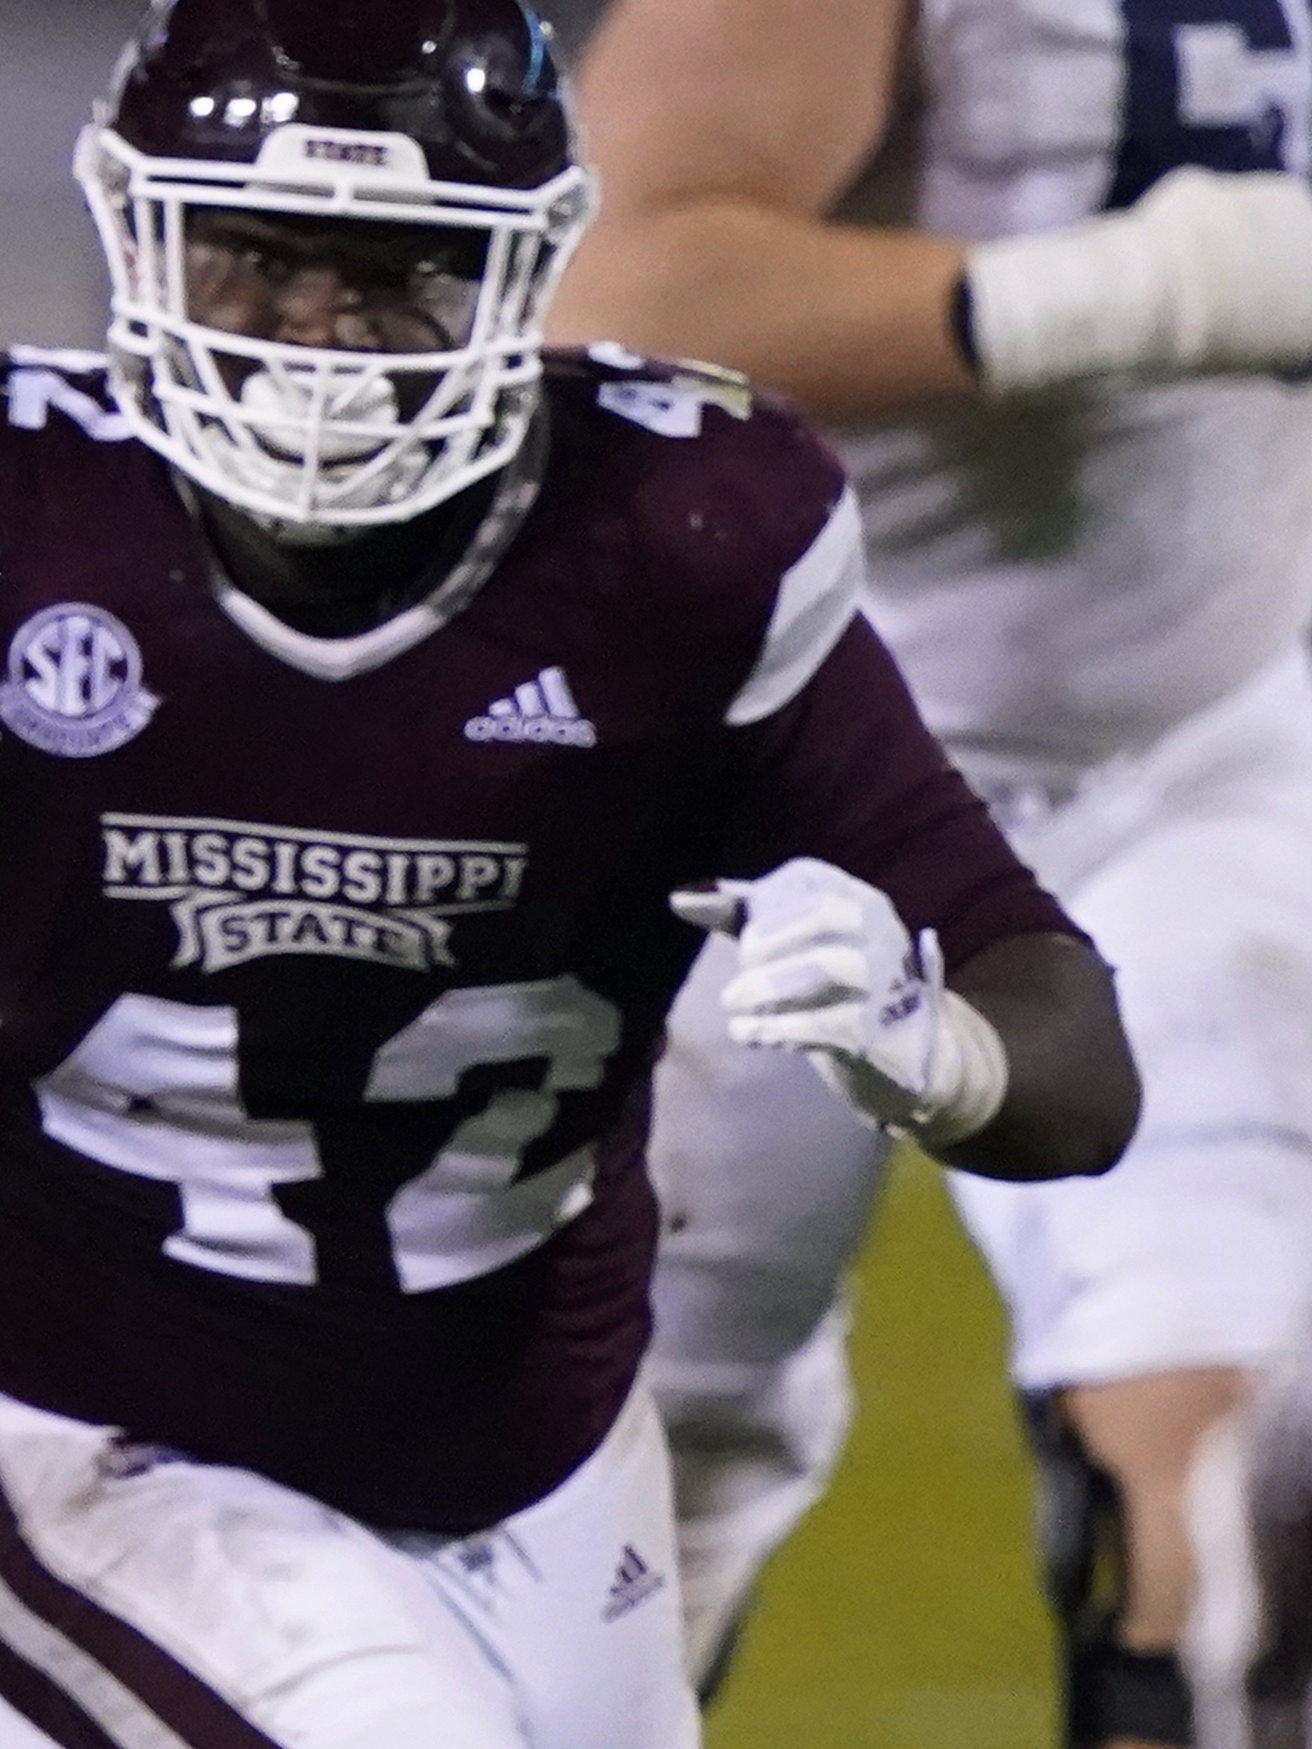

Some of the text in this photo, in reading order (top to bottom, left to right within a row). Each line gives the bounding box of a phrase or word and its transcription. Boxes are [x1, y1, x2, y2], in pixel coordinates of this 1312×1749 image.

[24, 615, 123, 719] SEC
[101, 827, 529, 904] MISSISSIPPI
[217, 910, 409, 954] STATE
[32, 974, 622, 1295] 42
